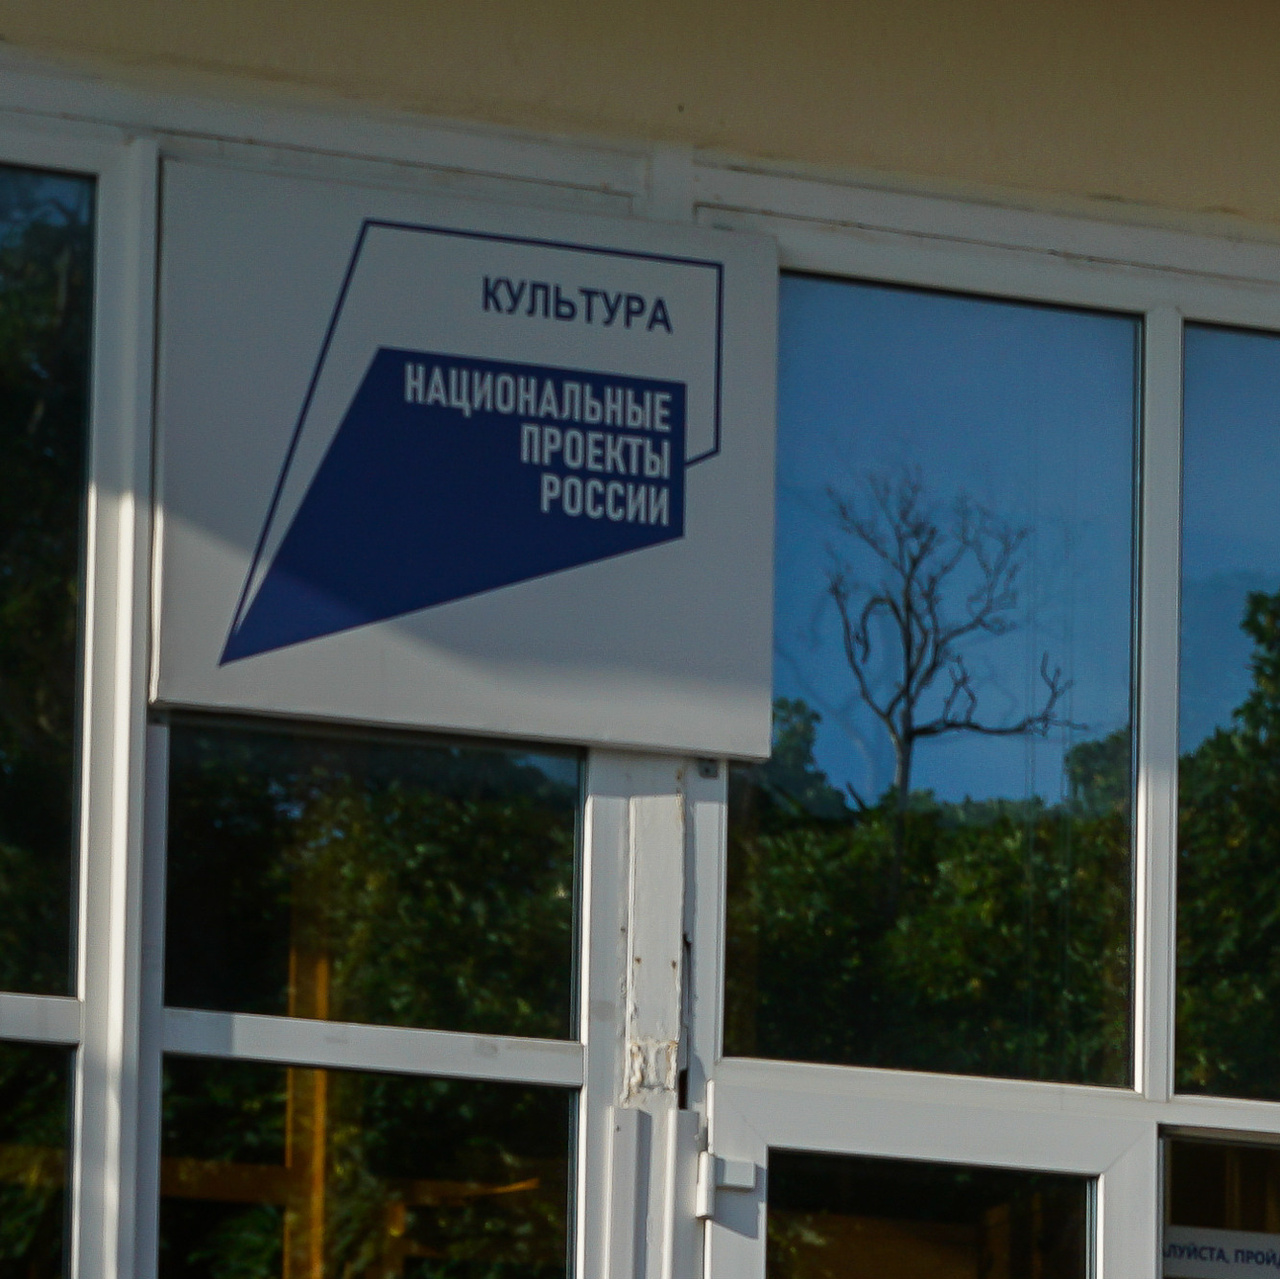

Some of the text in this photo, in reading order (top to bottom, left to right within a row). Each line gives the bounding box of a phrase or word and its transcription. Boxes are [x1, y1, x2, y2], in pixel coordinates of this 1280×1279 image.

[481, 275, 673, 333] КУЛЬТУРА
[404, 362, 672, 432] НАЦИОНАЛЬНЫЕ
[520, 423, 671, 479] ПРОЕКТЫ
[540, 473, 670, 527] РОССИИ
[1163, 1243, 1230, 1264] ЛУЙСТА,
